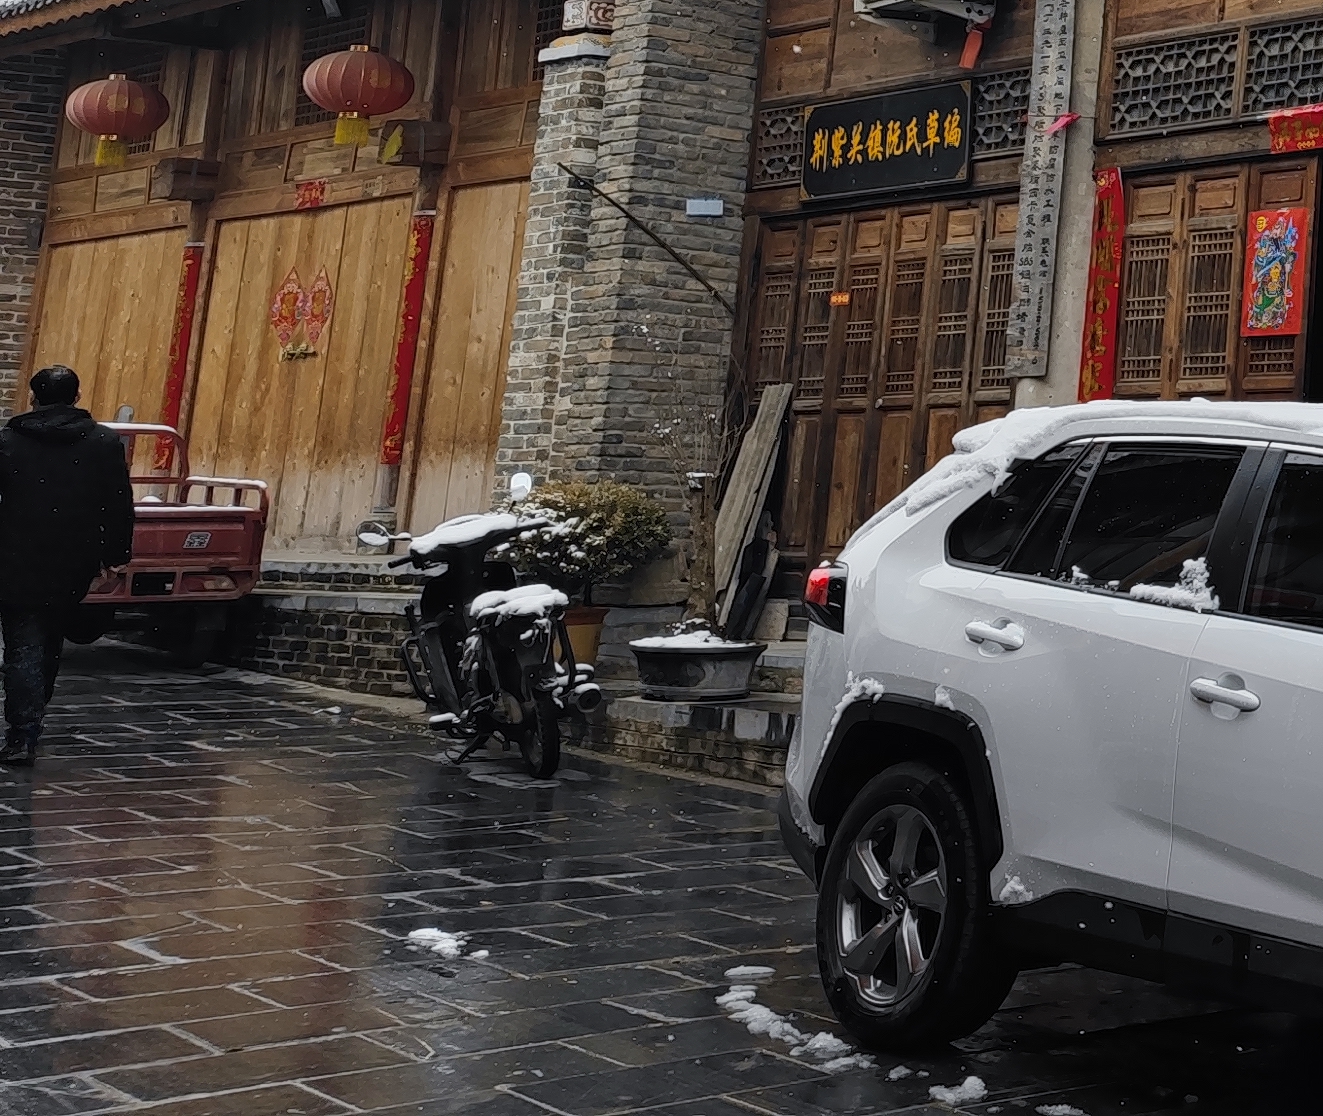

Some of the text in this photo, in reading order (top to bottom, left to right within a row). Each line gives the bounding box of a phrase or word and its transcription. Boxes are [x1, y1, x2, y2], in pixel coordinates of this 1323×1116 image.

[809, 107, 963, 173] 荆紫关镇阮氏草编
